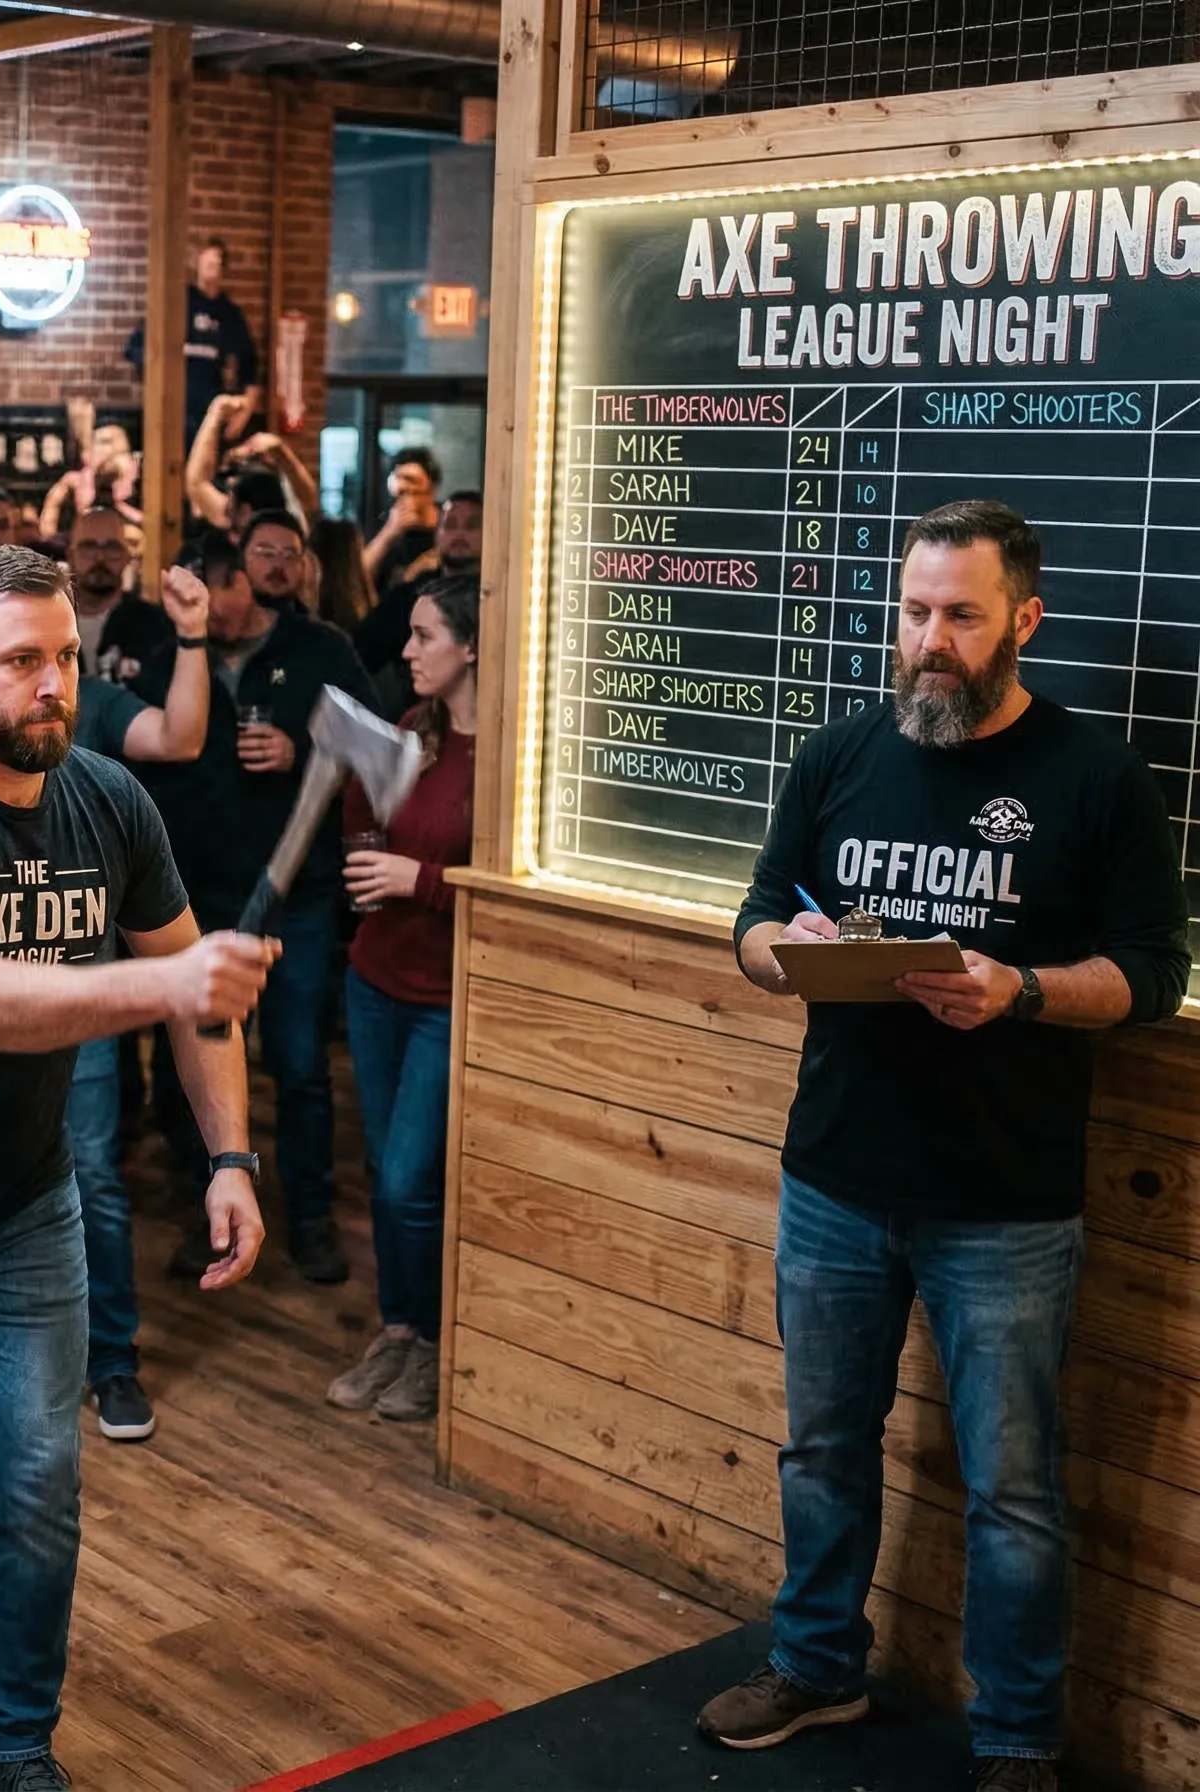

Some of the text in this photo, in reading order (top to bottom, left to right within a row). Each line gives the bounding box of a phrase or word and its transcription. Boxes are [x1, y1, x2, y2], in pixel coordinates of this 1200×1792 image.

[678, 181, 1200, 300] AXE THROWING
[738, 293, 1111, 368] LEAGUE NIGHT
[598, 391, 1143, 427] THE TIMBERWOLVES SHARP SHOOTERS
[616, 434, 684, 464] MIKE
[796, 436, 830, 466] 24
[859, 441, 879, 464] 14
[608, 472, 691, 503] SARAH
[795, 480, 822, 507] 21
[856, 484, 877, 504] 10
[569, 513, 871, 550] 3 DAVE 18 8
[569, 552, 581, 577] 4
[593, 550, 654, 581] SHARP
[658, 555, 758, 588] SHOOTERS
[853, 569, 874, 591] 12
[566, 590, 868, 635] 5 DABH 18 16
[565, 629, 863, 678] 6 SARAH 14 8
[563, 669, 577, 690] 7
[592, 668, 656, 701] SHARP
[659, 675, 765, 713] SHOOTERS
[784, 691, 815, 718] 25
[563, 706, 575, 729] 8
[607, 709, 668, 742] DAVE
[561, 745, 746, 794] 9 TIMBERWOLVES
[13, 859, 50, 885] THE
[836, 838, 1022, 904] OFFICIAL
[35, 886, 106, 941] DEN
[859, 893, 991, 930] LEAGUE NIGHT
